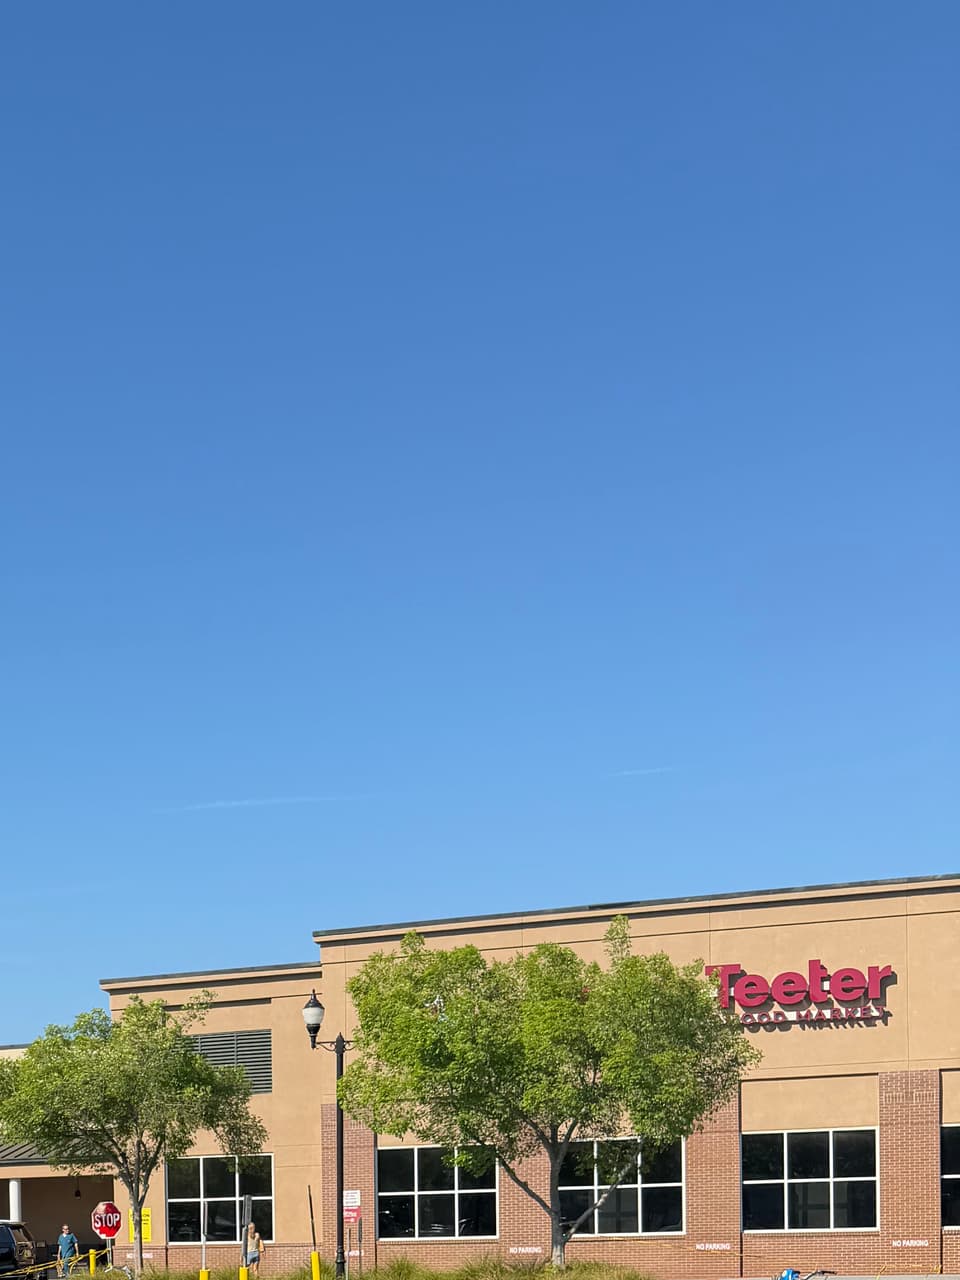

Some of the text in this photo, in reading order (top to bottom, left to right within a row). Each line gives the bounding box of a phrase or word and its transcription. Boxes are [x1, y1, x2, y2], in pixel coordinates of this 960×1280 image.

[705, 959, 892, 1009] Teeter
[740, 1005, 887, 1025] OOD MARKET
[94, 1213, 120, 1228] STOP
[705, 1242, 731, 1250] PARKING
[892, 1239, 929, 1247] NO PARKING
[518, 1246, 542, 1254] PARKING
